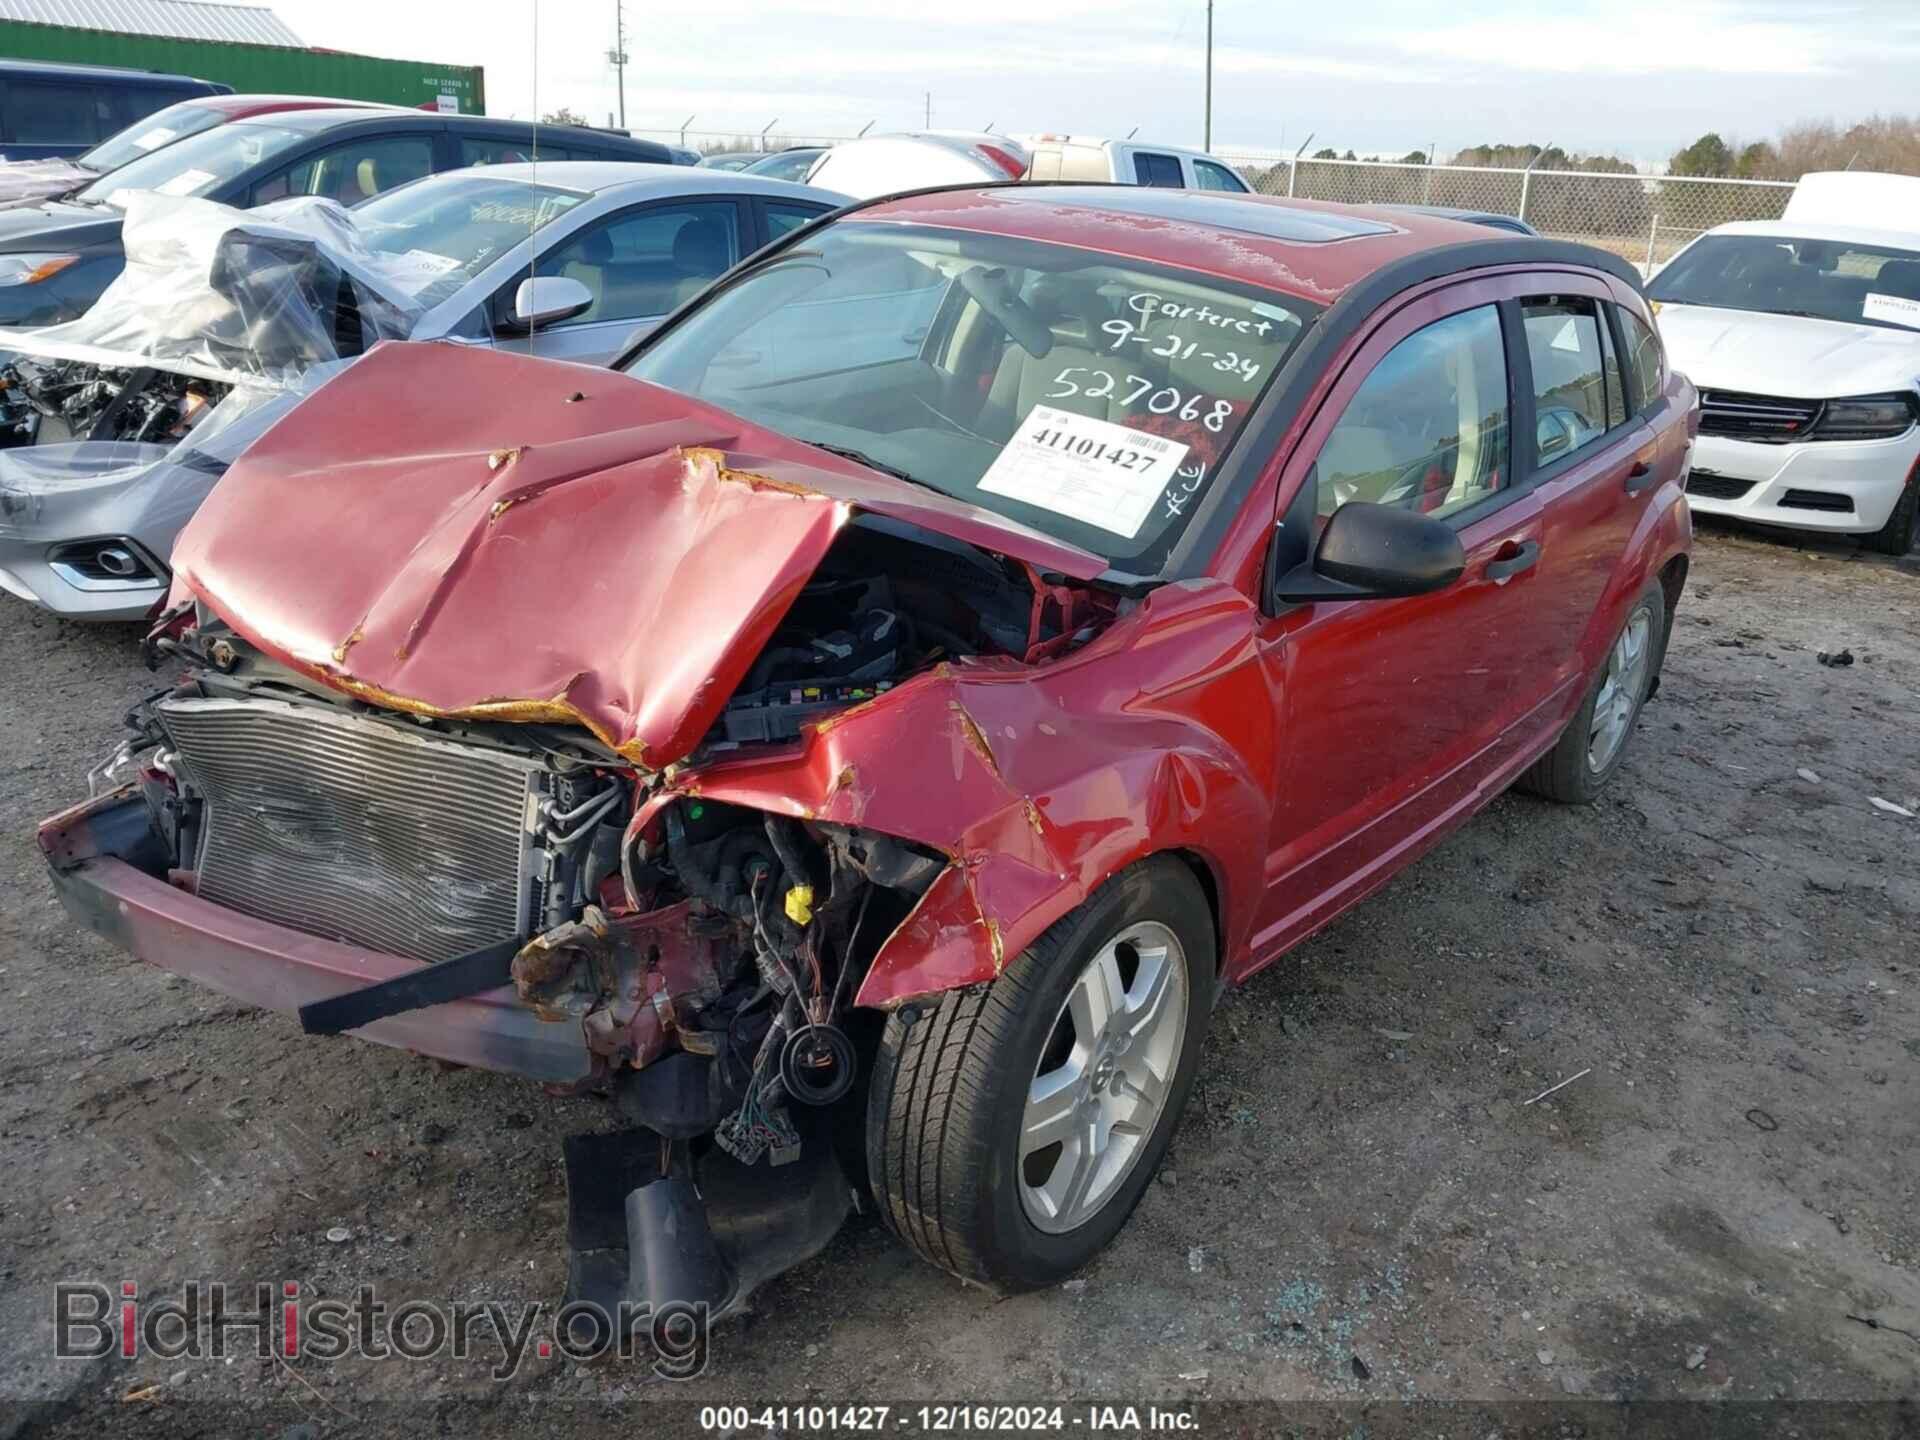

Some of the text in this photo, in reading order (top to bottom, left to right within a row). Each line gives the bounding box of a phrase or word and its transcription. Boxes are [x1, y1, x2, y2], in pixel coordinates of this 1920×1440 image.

[1128, 293, 1273, 337] Carteret
[1101, 319, 1261, 383] 9-21-24
[1045, 367, 1234, 433] 527068
[1031, 428, 1157, 474] 41101427
